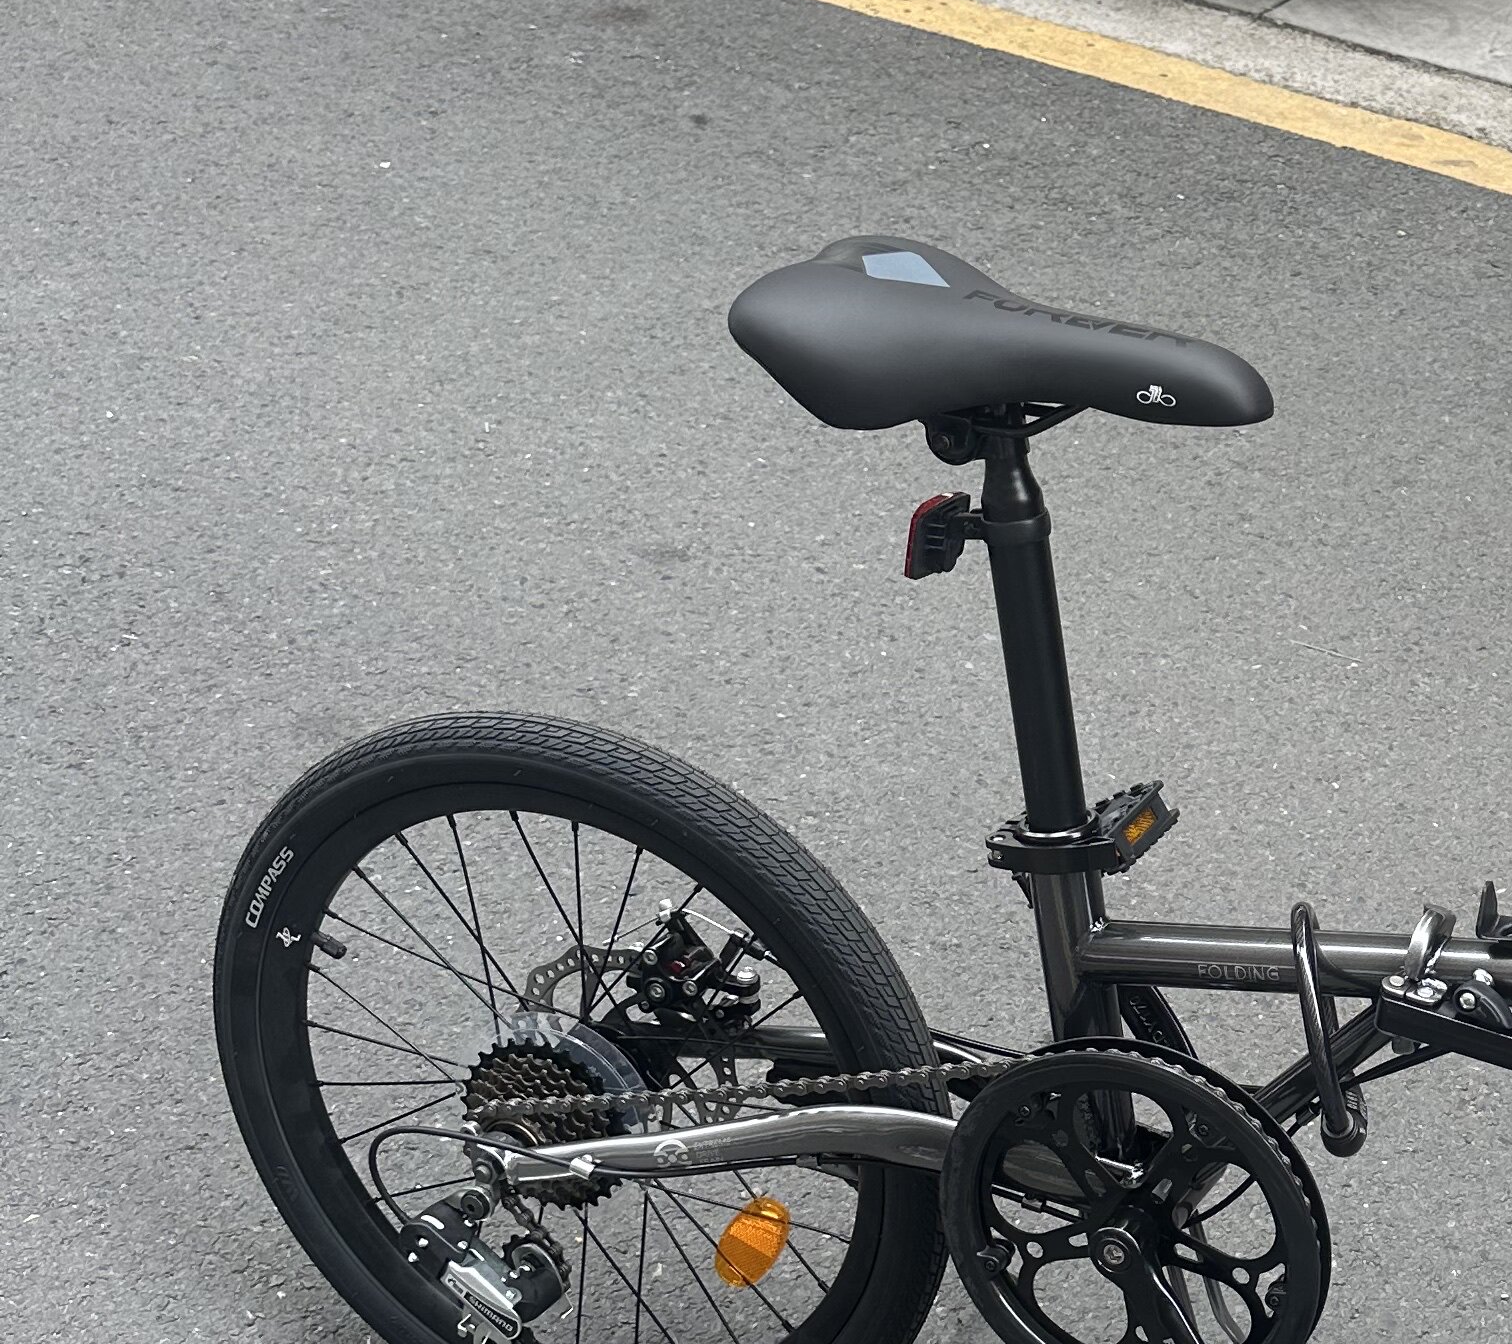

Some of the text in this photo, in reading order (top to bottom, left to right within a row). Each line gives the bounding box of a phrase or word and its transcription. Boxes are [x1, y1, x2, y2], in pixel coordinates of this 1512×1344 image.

[245, 845, 295, 929] COMPASS
[1197, 964, 1280, 982] FOLDING
[468, 1295, 514, 1332] SHIMANO
